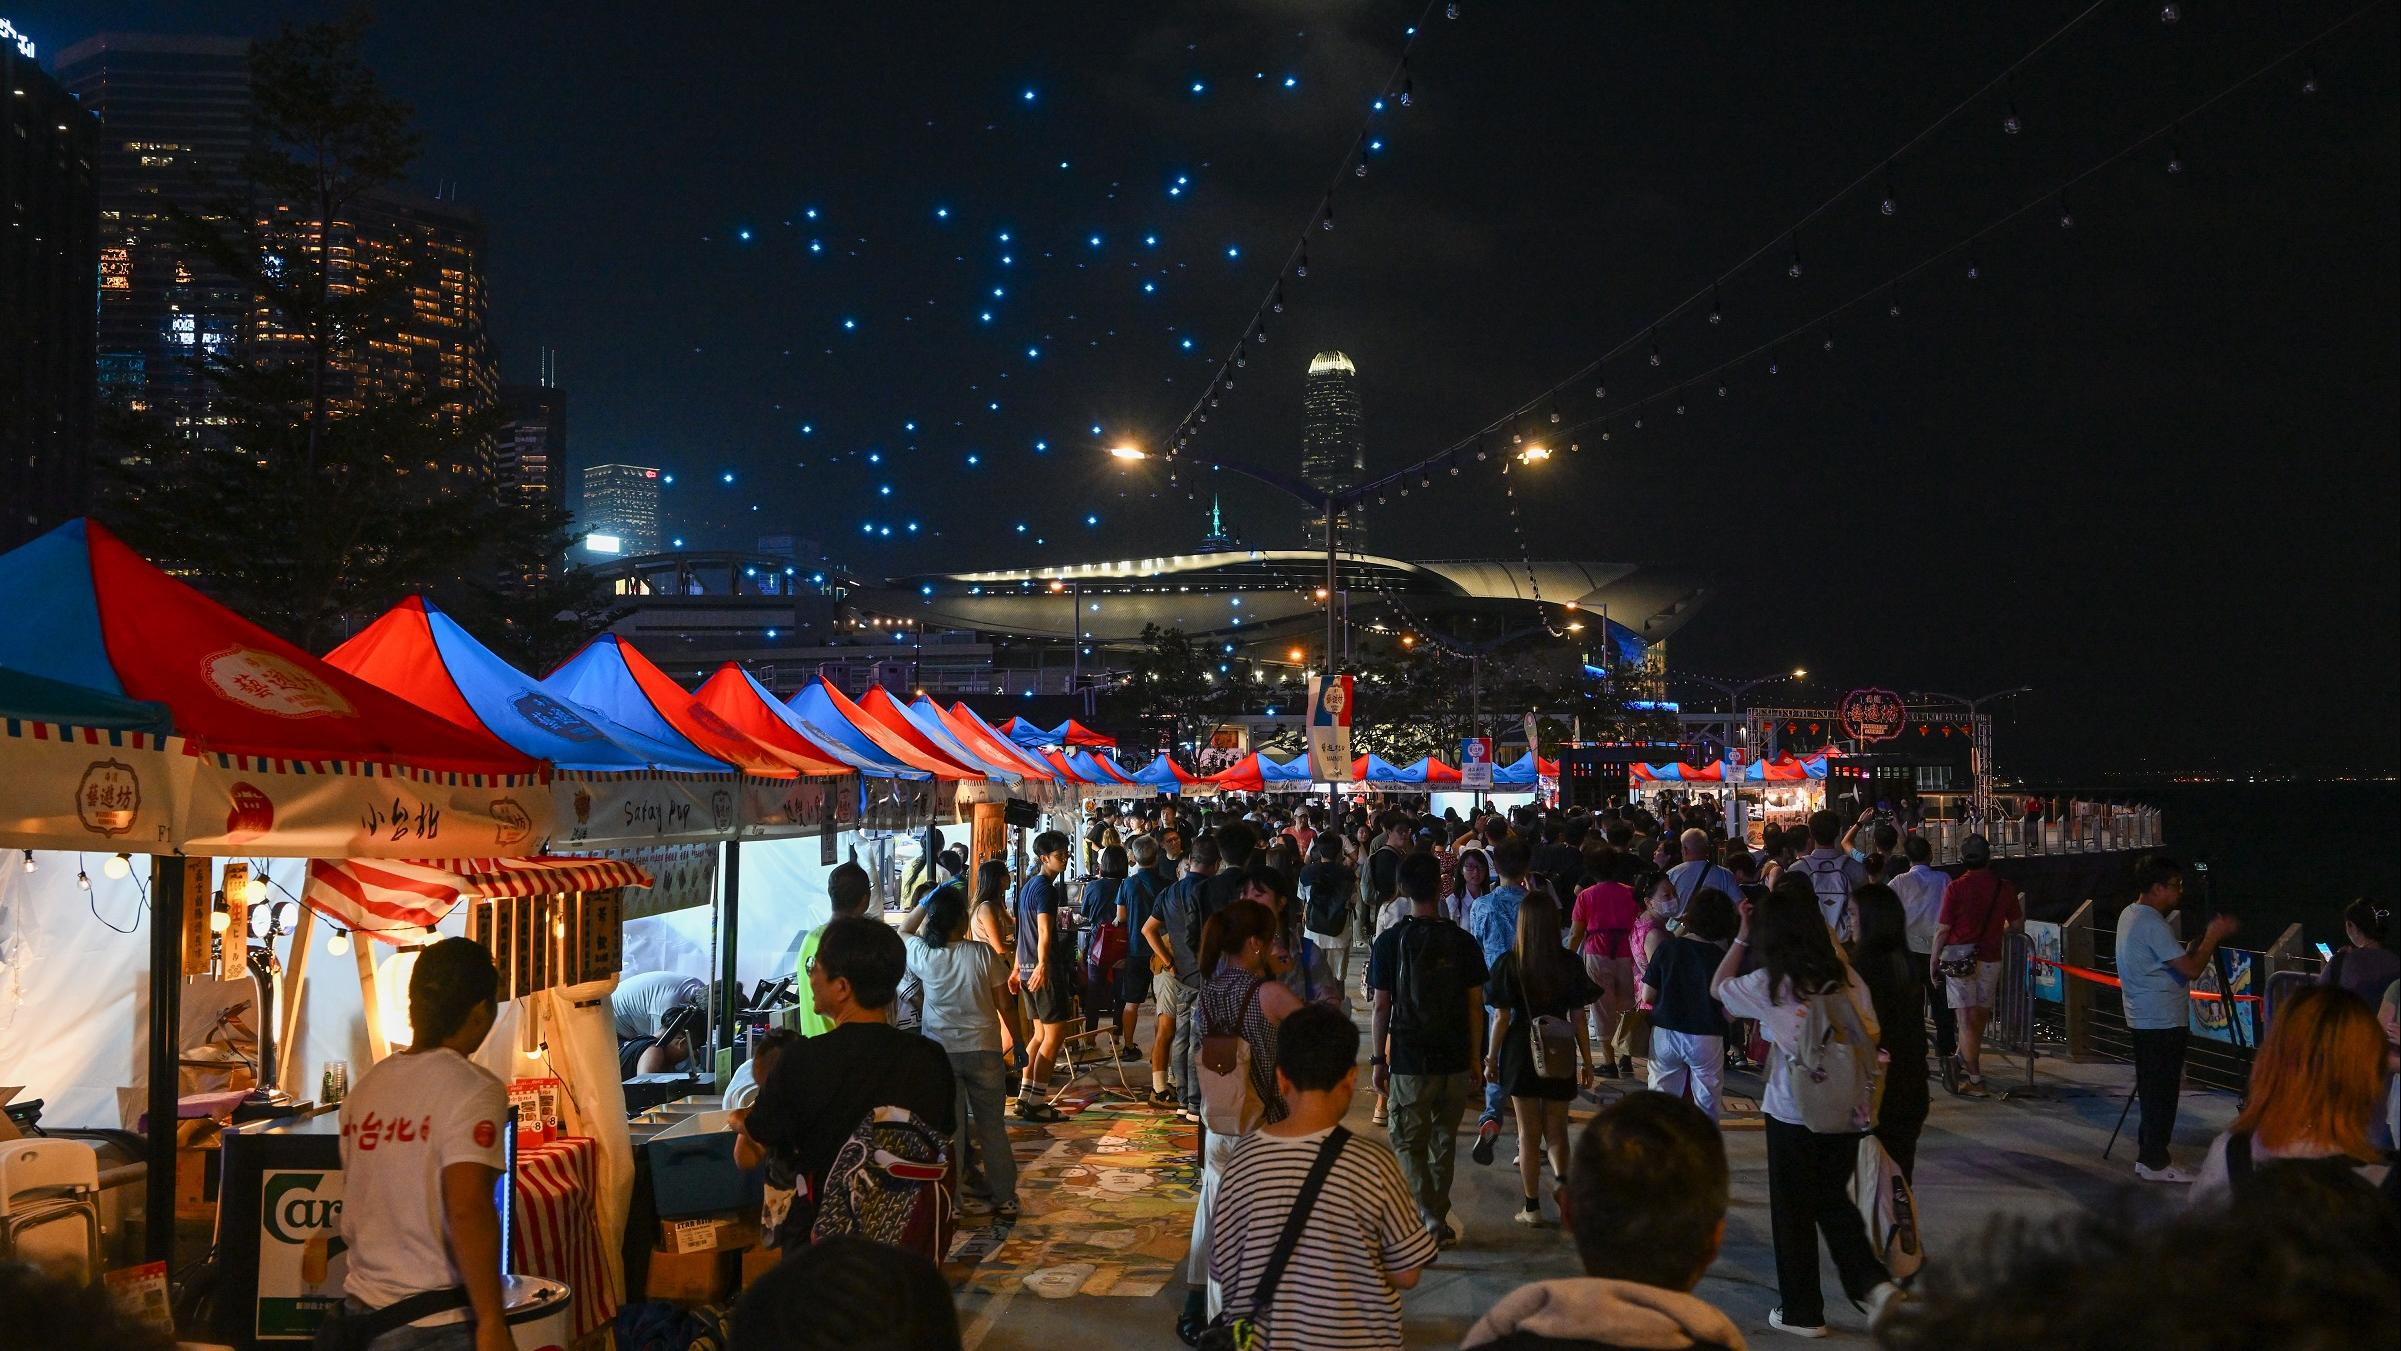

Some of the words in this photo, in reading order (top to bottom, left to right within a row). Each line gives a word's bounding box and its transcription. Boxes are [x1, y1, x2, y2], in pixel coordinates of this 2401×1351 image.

[86, 783, 132, 809] 藝遊坊
[361, 797, 440, 841] 小台北
[669, 799, 690, 831] Pop
